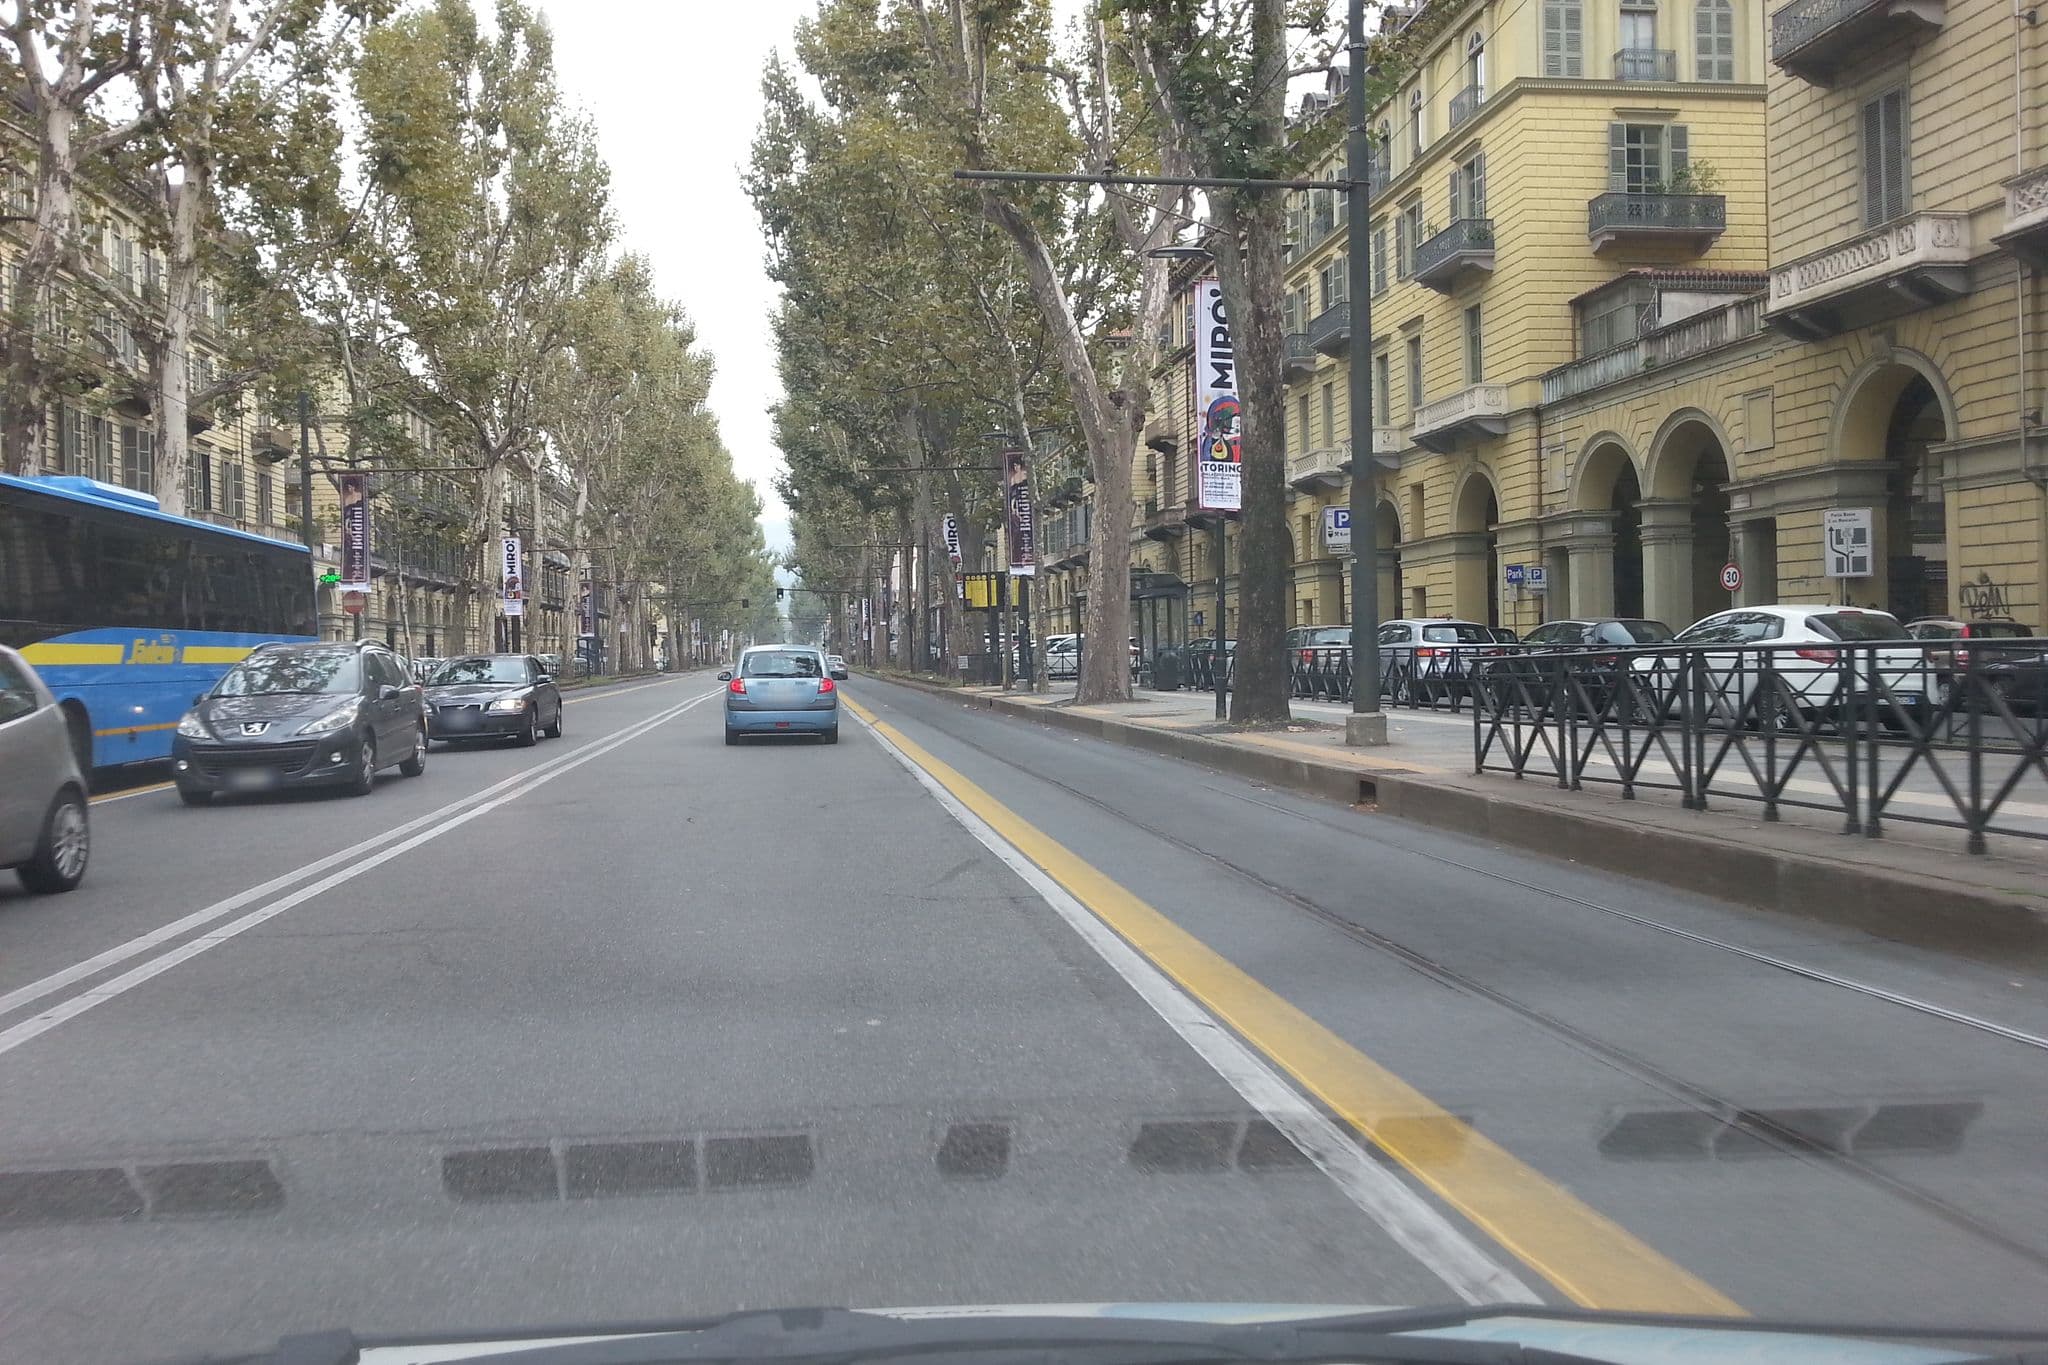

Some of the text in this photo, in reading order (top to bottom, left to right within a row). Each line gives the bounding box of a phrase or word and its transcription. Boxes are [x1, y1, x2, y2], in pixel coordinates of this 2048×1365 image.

[1338, 512, 1349, 526] P
[351, 507, 364, 550] Boldini
[1507, 568, 1523, 579] Park
[1533, 570, 1541, 579] P
[1725, 571, 1738, 583] 30
